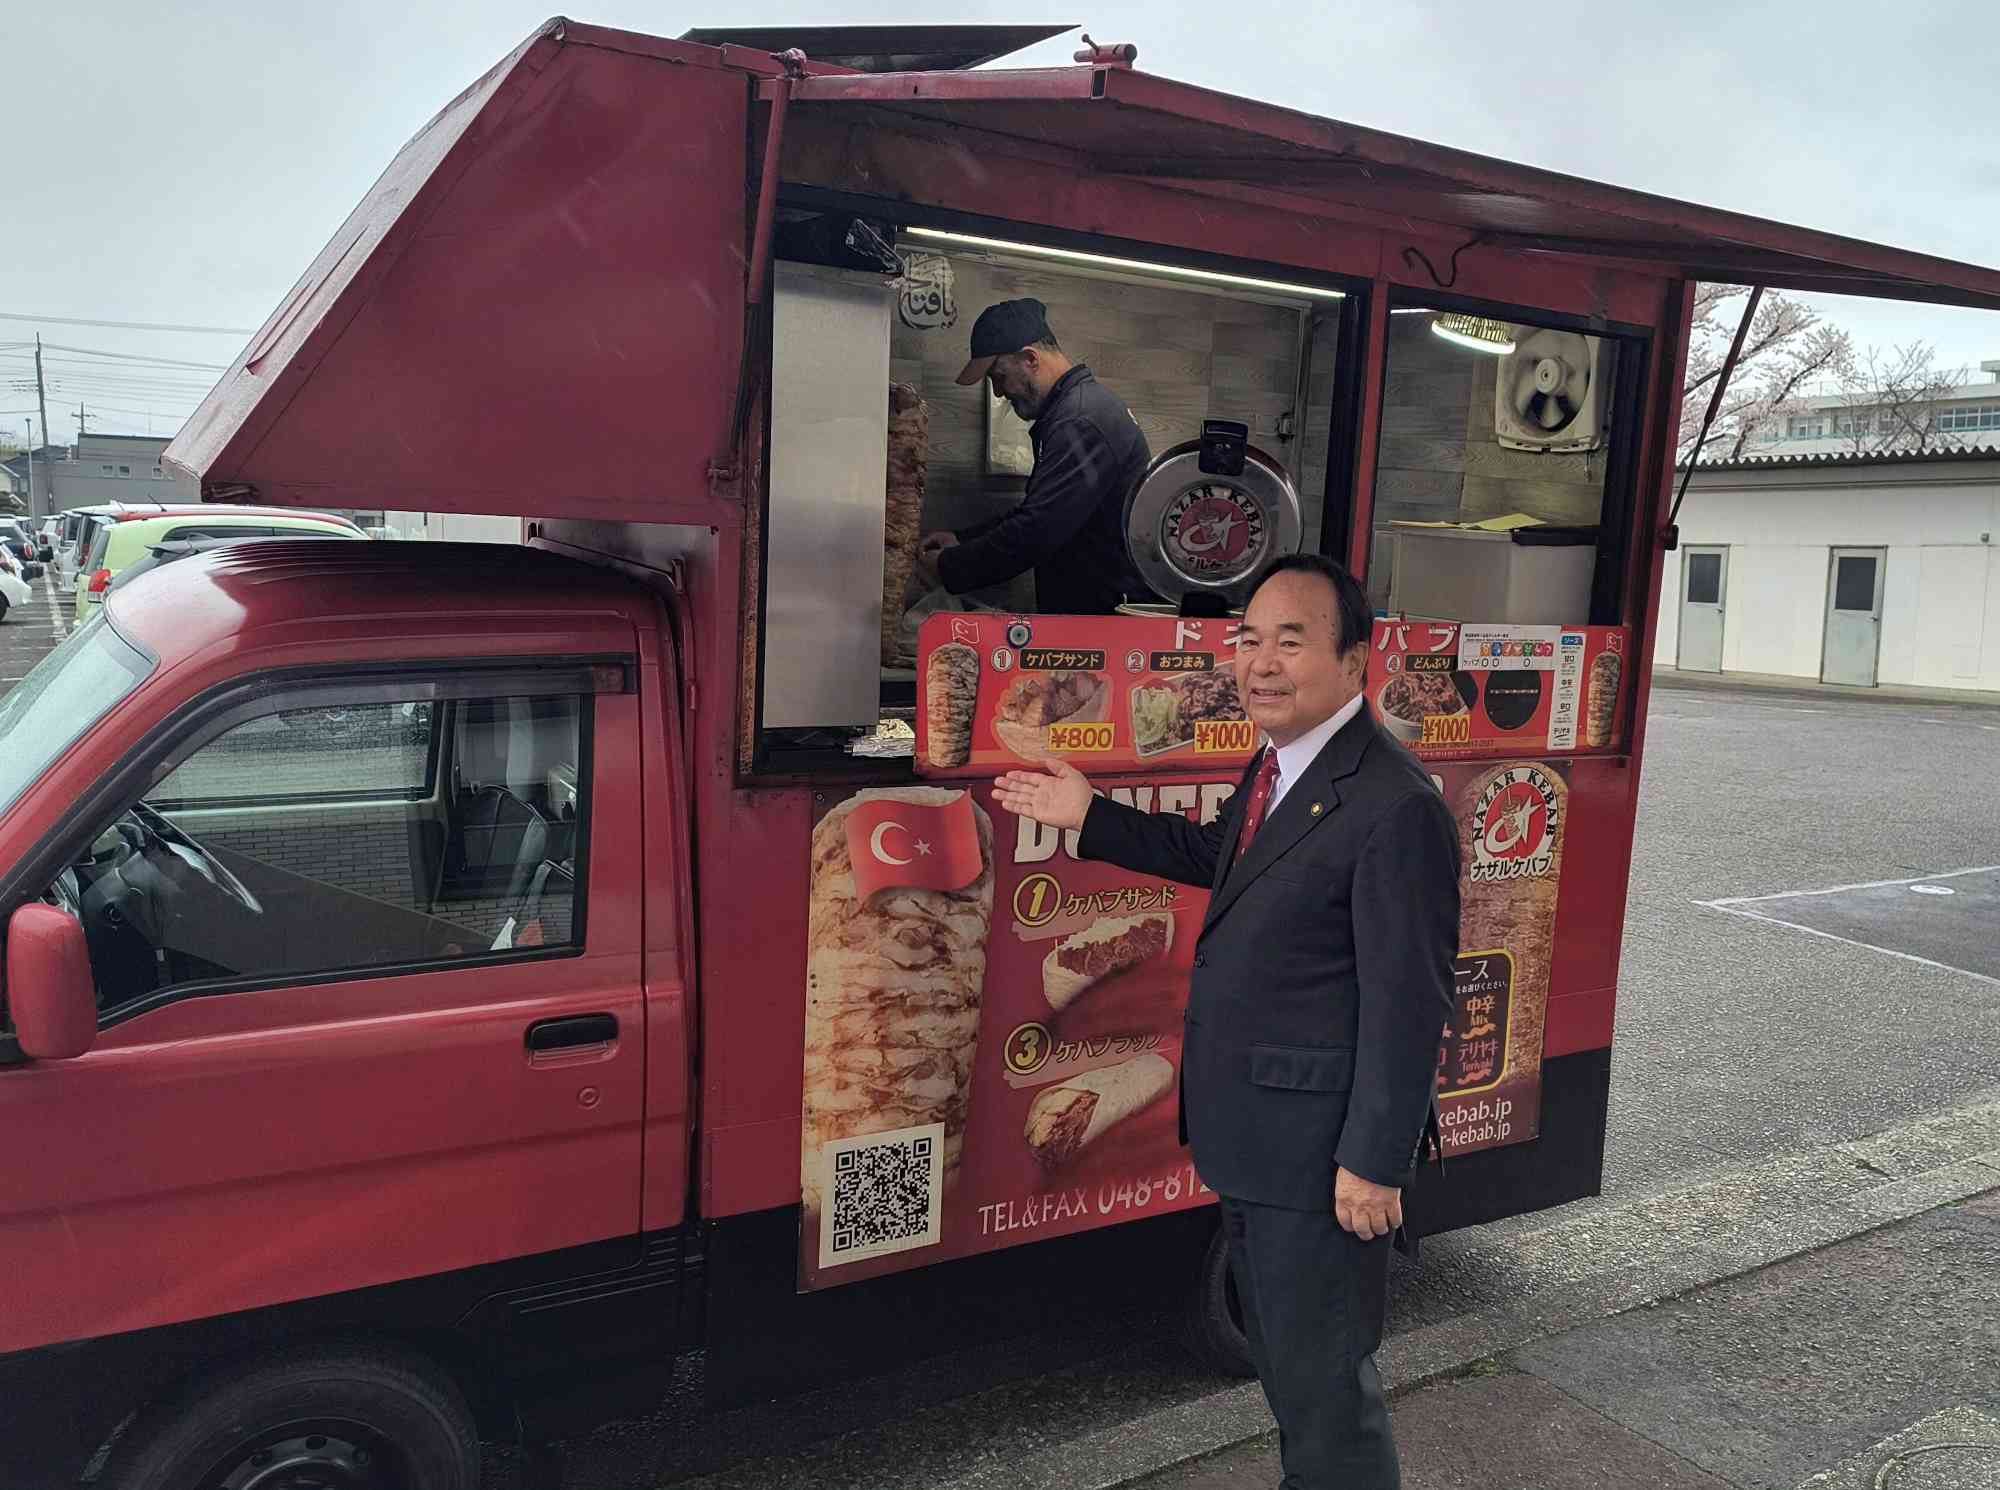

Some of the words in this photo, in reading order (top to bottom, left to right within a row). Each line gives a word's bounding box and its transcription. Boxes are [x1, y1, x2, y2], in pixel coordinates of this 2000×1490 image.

[1169, 487, 1214, 537] NAZAR
[1024, 652, 1100, 668] ケバブサンド
[1159, 655, 1205, 669] おつまみ
[1413, 656, 1451, 669] どんぶり
[1050, 726, 1112, 749] ¥800
[1196, 724, 1251, 750] ¥1000
[1424, 718, 1468, 742] ¥1000
[1473, 771, 1516, 841] NAZAR
[1527, 770, 1558, 837] KEBAB
[1471, 856, 1551, 880] ナザルケバブ
[1064, 885, 1177, 917] ケバブサンド
[1466, 994, 1496, 1015] 中辛
[1457, 1038, 1499, 1062] テリヤキ
[978, 1187, 1089, 1235] TEL&FAX
